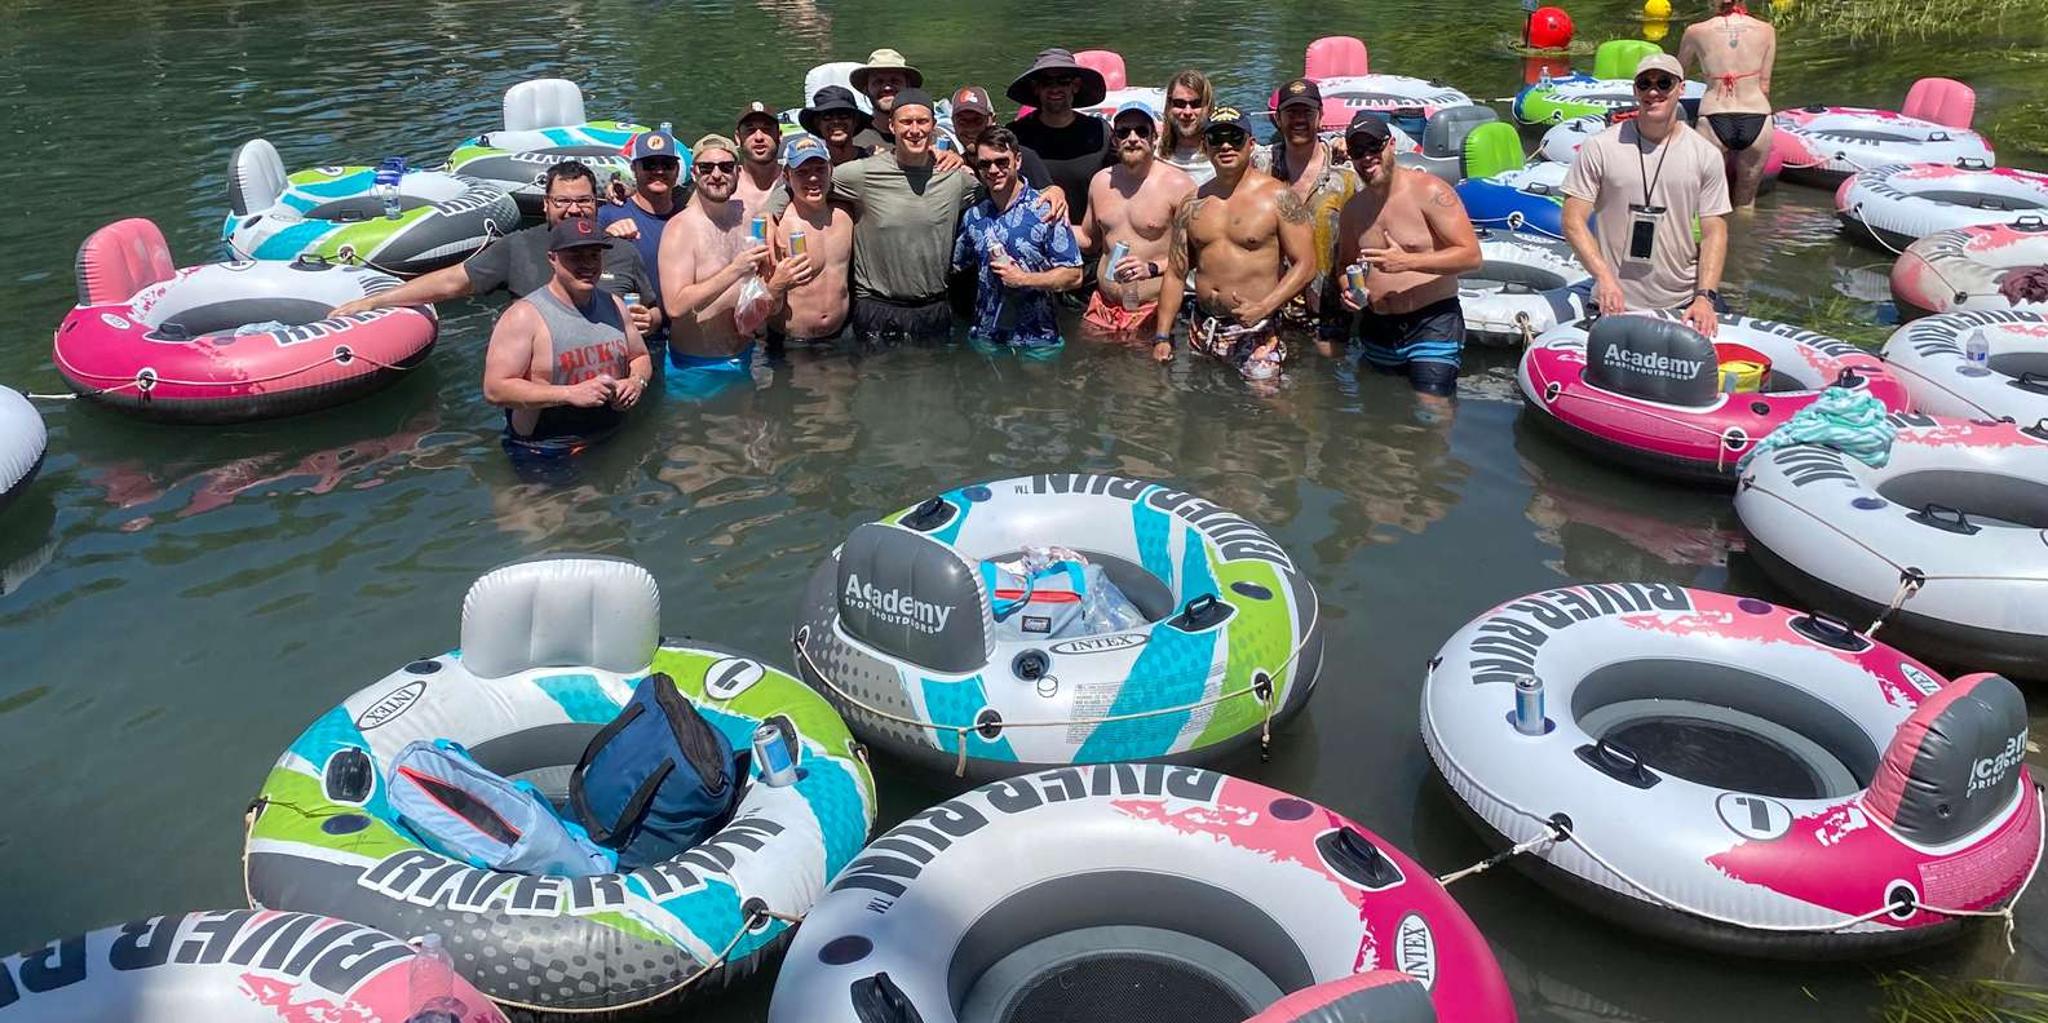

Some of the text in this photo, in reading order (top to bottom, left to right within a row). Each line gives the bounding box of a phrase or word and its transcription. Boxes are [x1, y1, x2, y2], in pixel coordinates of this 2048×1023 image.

[1604, 343, 1702, 379] Academy
[1149, 485, 1294, 572] RIVER
[845, 573, 951, 633] Academy
[1070, 635, 1134, 652] INTEX
[1468, 582, 1692, 685] RIVER RUN
[366, 689, 417, 724] INTEX
[978, 763, 1225, 814] RIVER
[358, 848, 628, 916] RIVER
[634, 817, 787, 899] RUN
[829, 801, 990, 898] RUN
[108, 909, 418, 996] RIVER
[1403, 923, 1430, 981] INTEX
